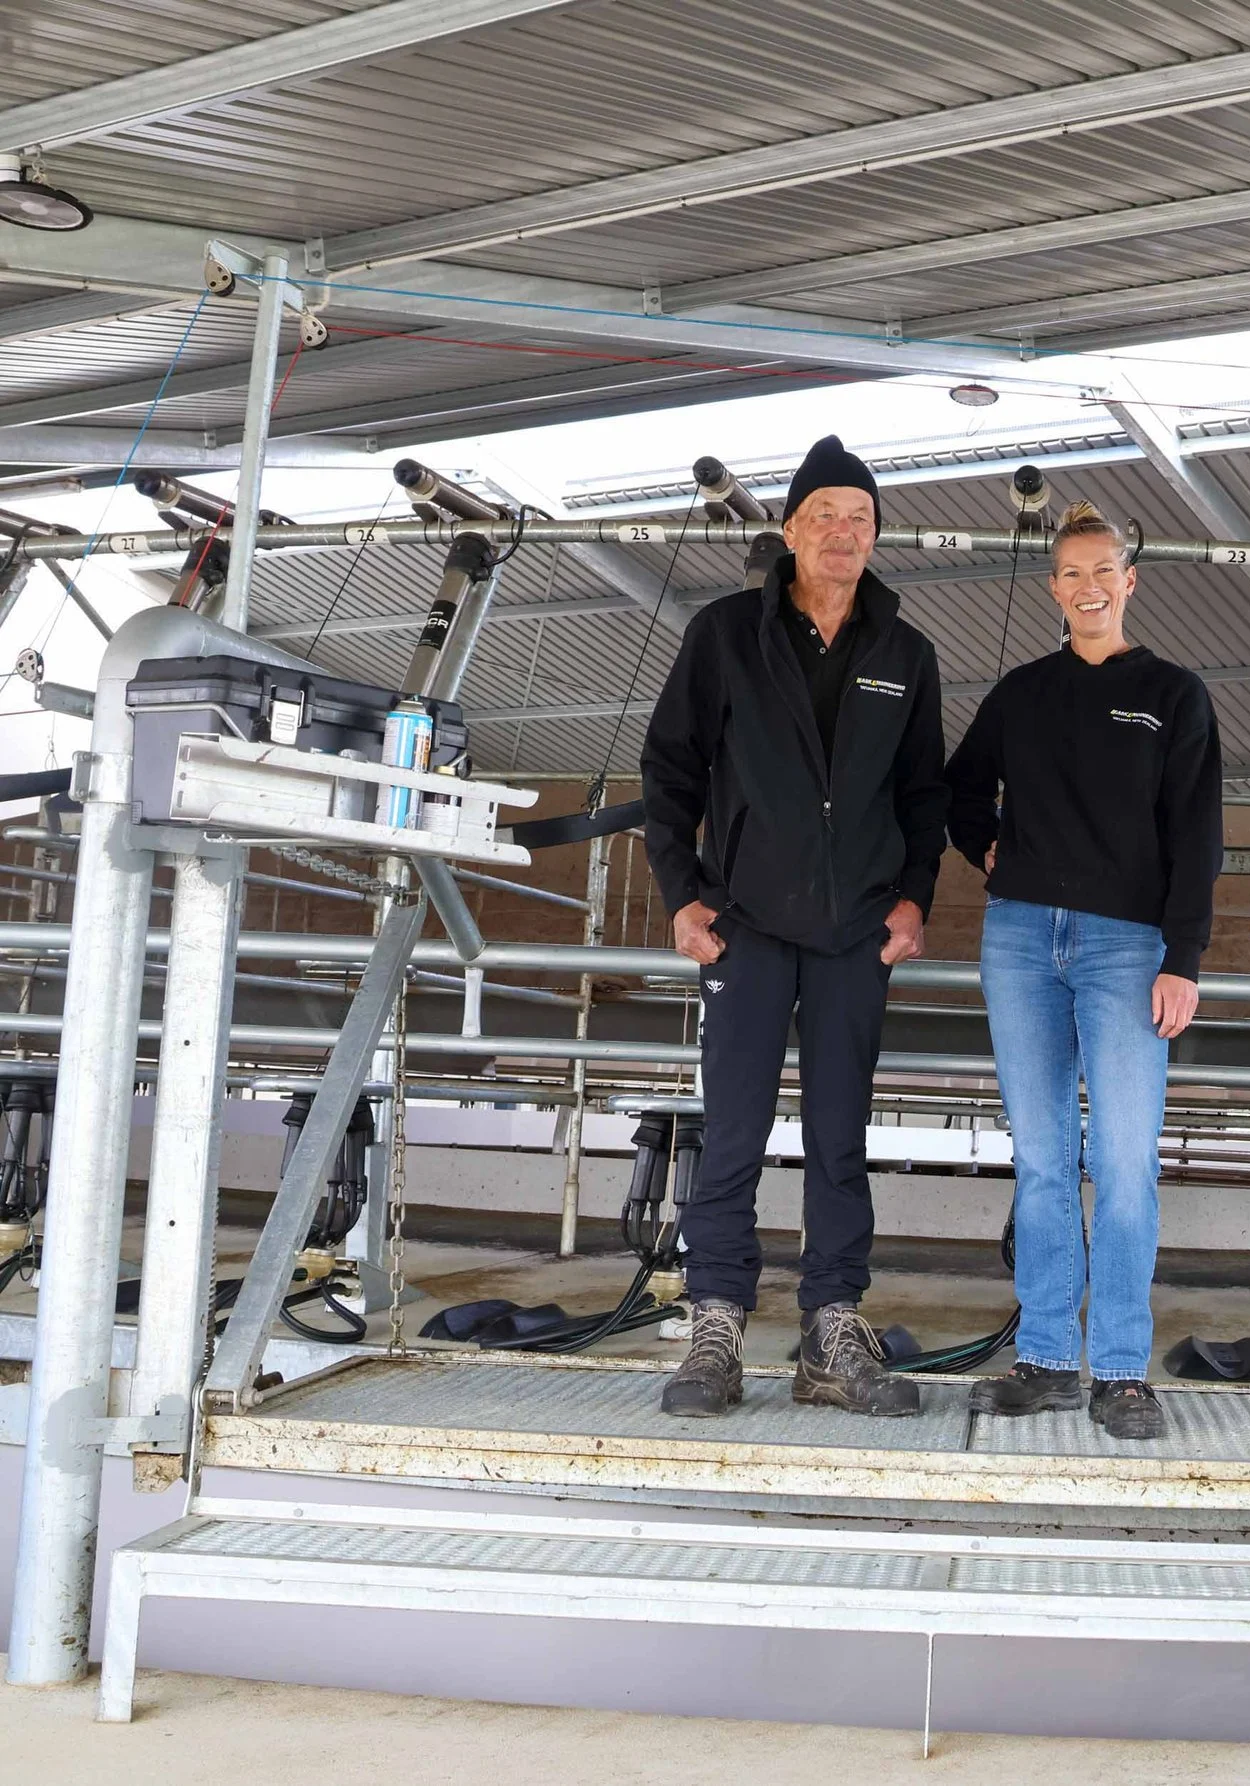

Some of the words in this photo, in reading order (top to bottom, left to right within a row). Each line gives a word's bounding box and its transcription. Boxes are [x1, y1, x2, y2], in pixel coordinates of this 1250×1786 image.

[357, 529, 375, 542] 26
[630, 527, 650, 541] 25
[937, 534, 958, 548] 24
[121, 537, 136, 551] 27
[1227, 549, 1247, 564] 23
[427, 617, 450, 629] CR
